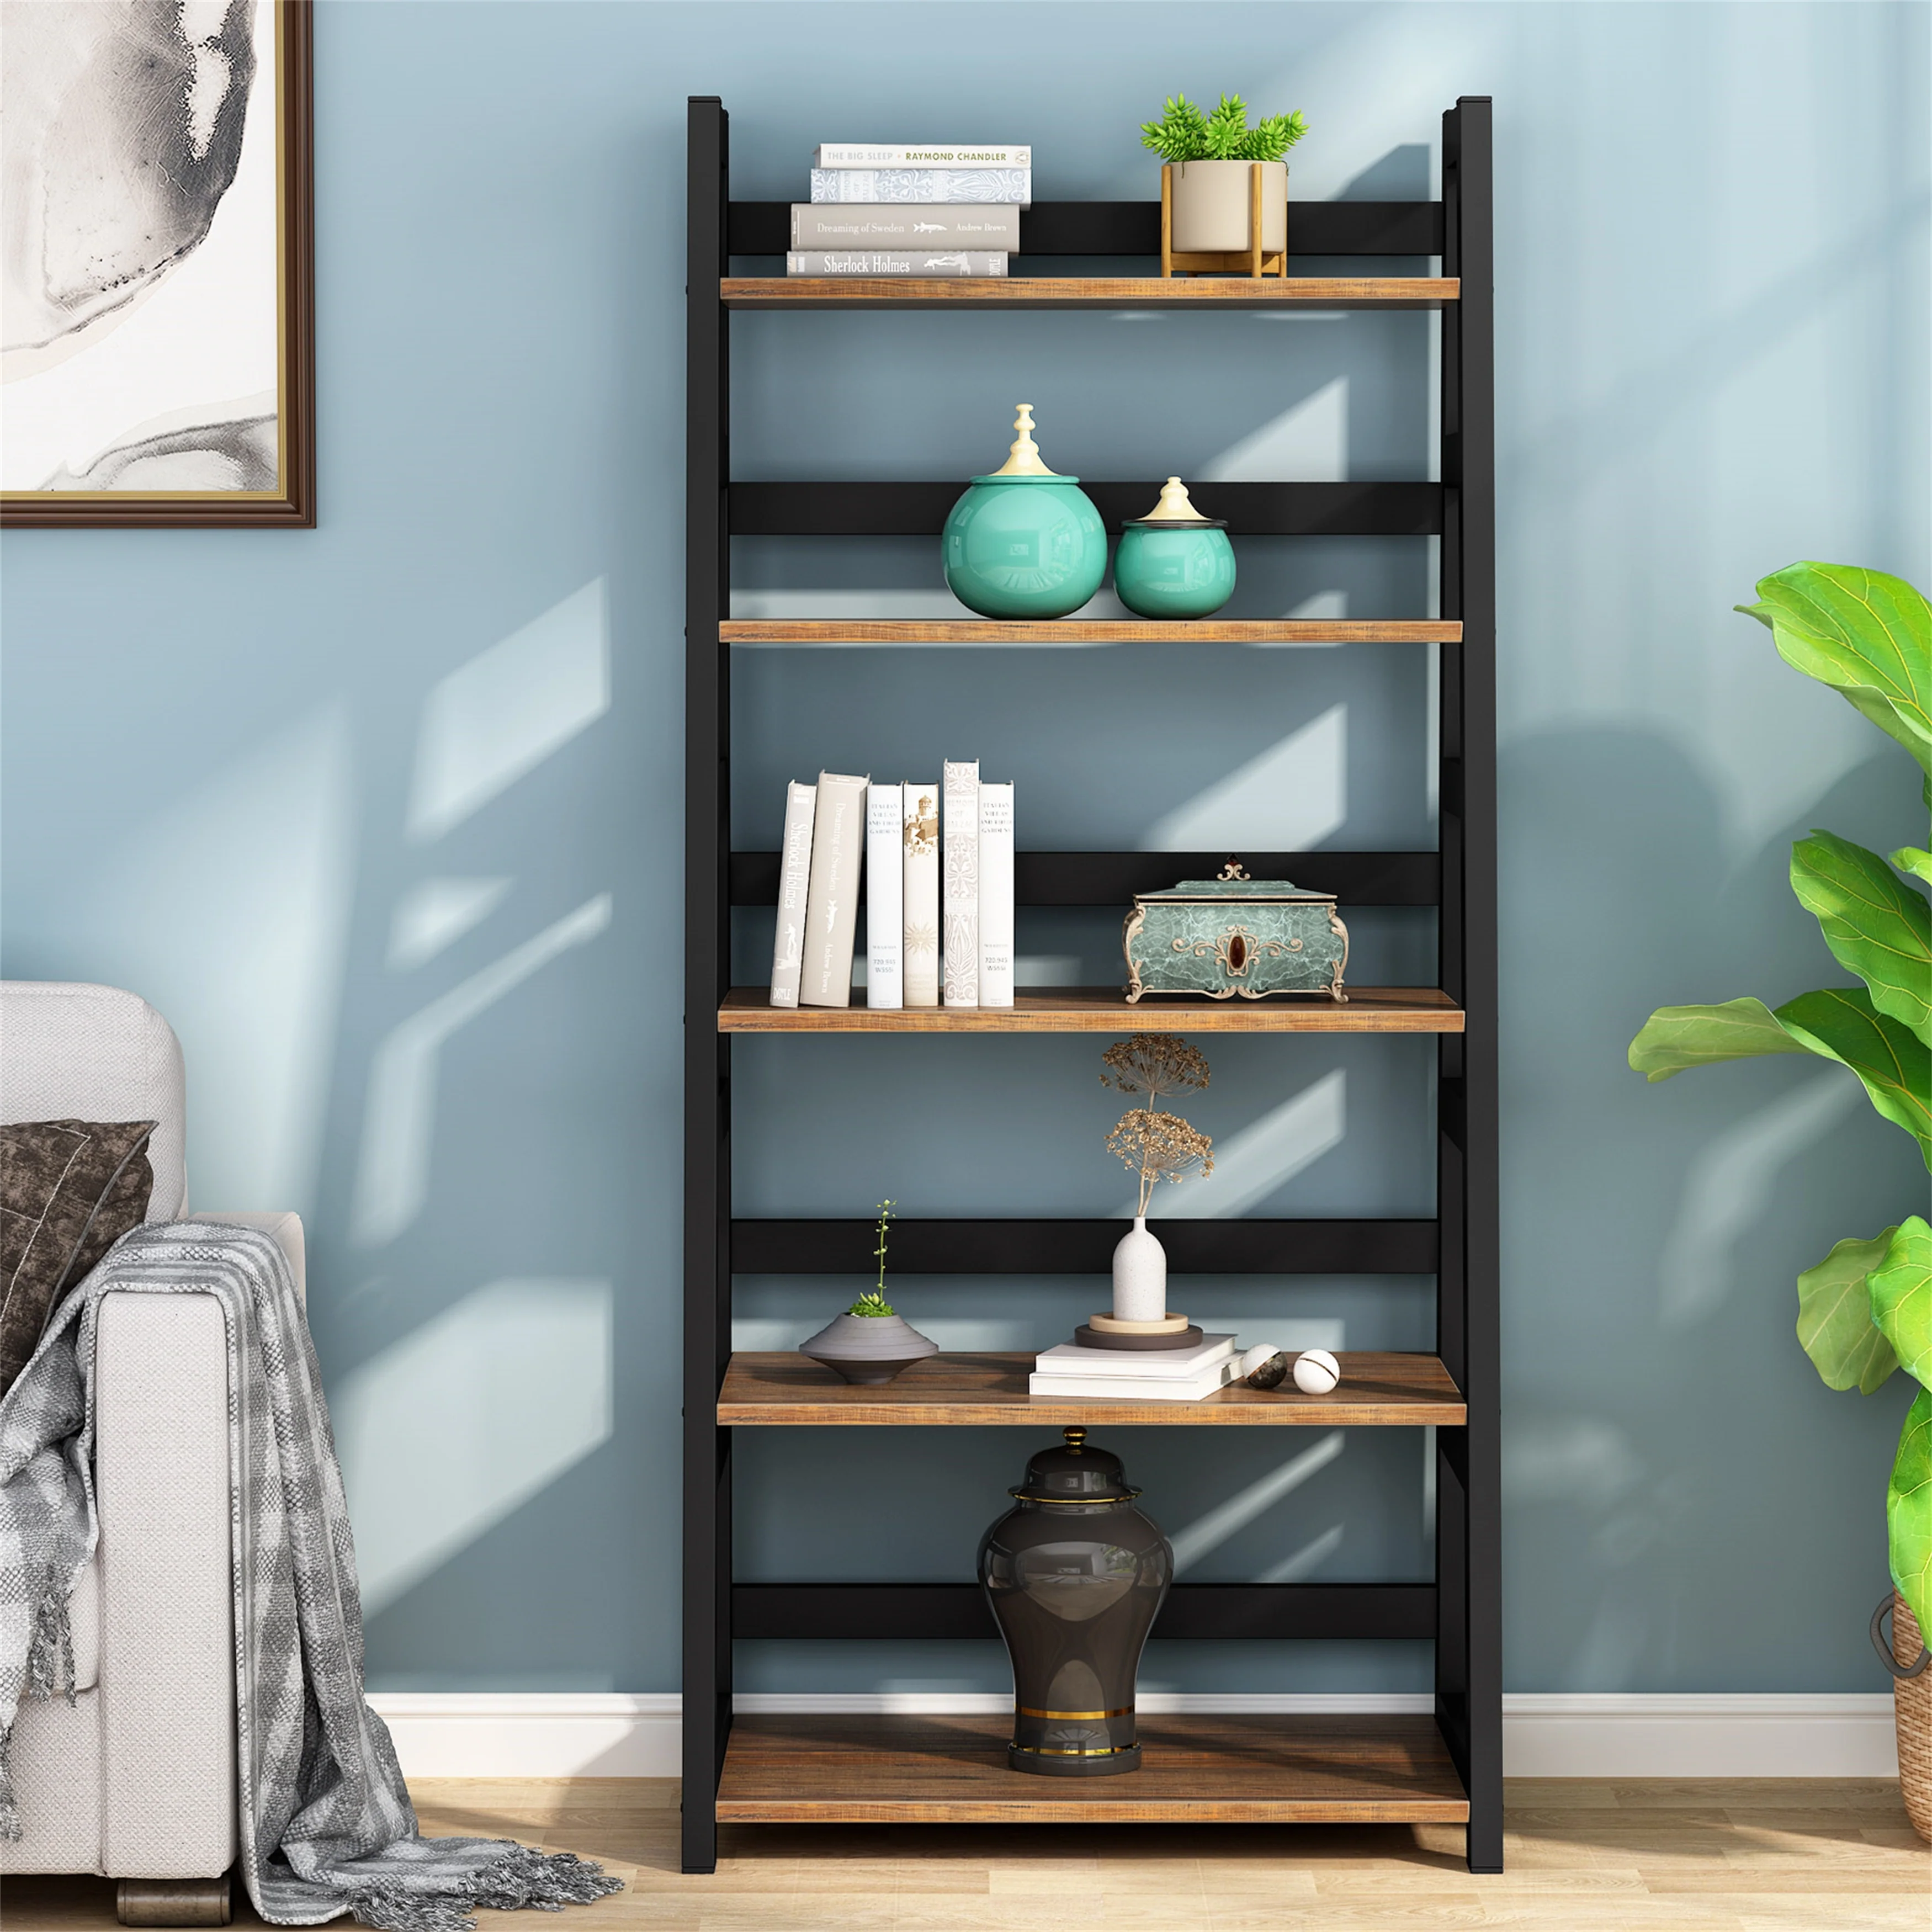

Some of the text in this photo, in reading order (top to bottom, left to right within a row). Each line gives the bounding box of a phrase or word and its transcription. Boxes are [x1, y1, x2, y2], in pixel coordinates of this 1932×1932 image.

[906, 152, 954, 161] RAYMOND
[957, 152, 1006, 161] CHANDLER
[818, 223, 905, 235] Dreaming of Sweden
[956, 223, 1007, 231] Andrew Brown
[824, 256, 910, 272] Sherlock Holmes
[829, 803, 846, 891] Dreaming of Sweden
[784, 822, 809, 909] Sherlock Holmes
[773, 988, 792, 1000] DOYLE
